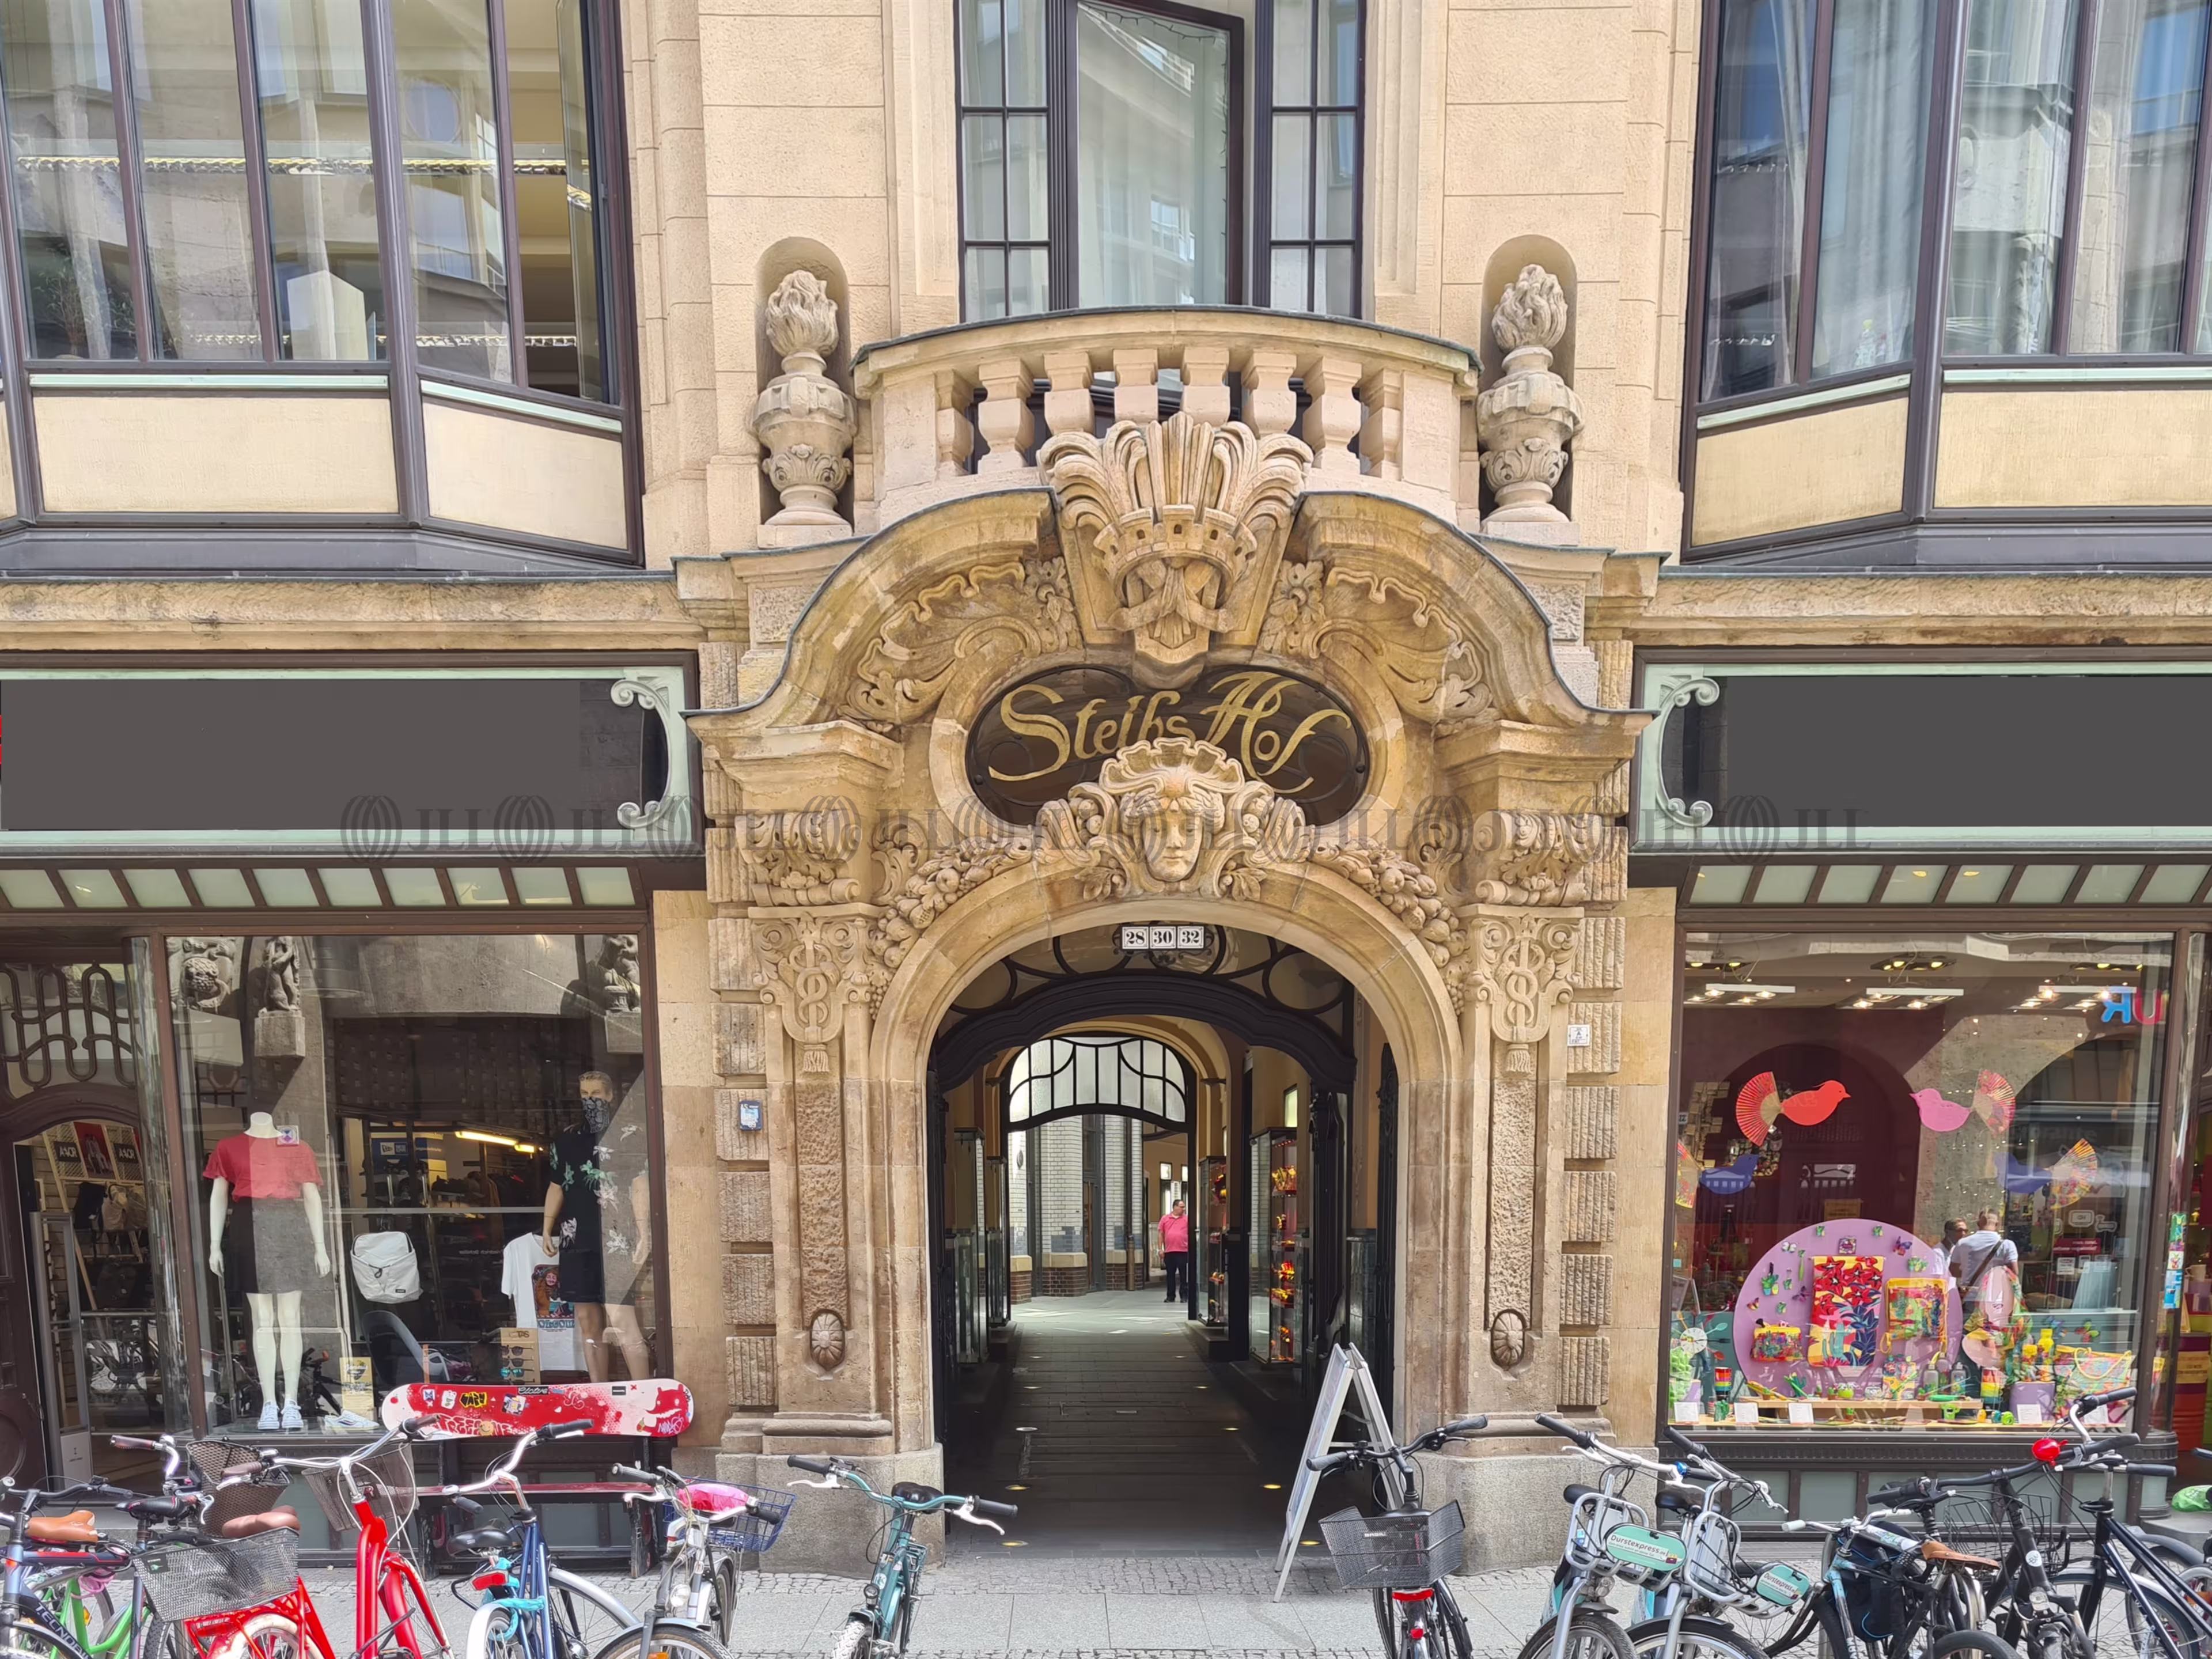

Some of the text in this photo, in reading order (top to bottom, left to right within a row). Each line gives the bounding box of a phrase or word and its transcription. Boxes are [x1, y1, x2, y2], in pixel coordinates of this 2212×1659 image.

[1200, 671, 1351, 794] Hof
[1126, 930, 1199, 945] 28 30 32
